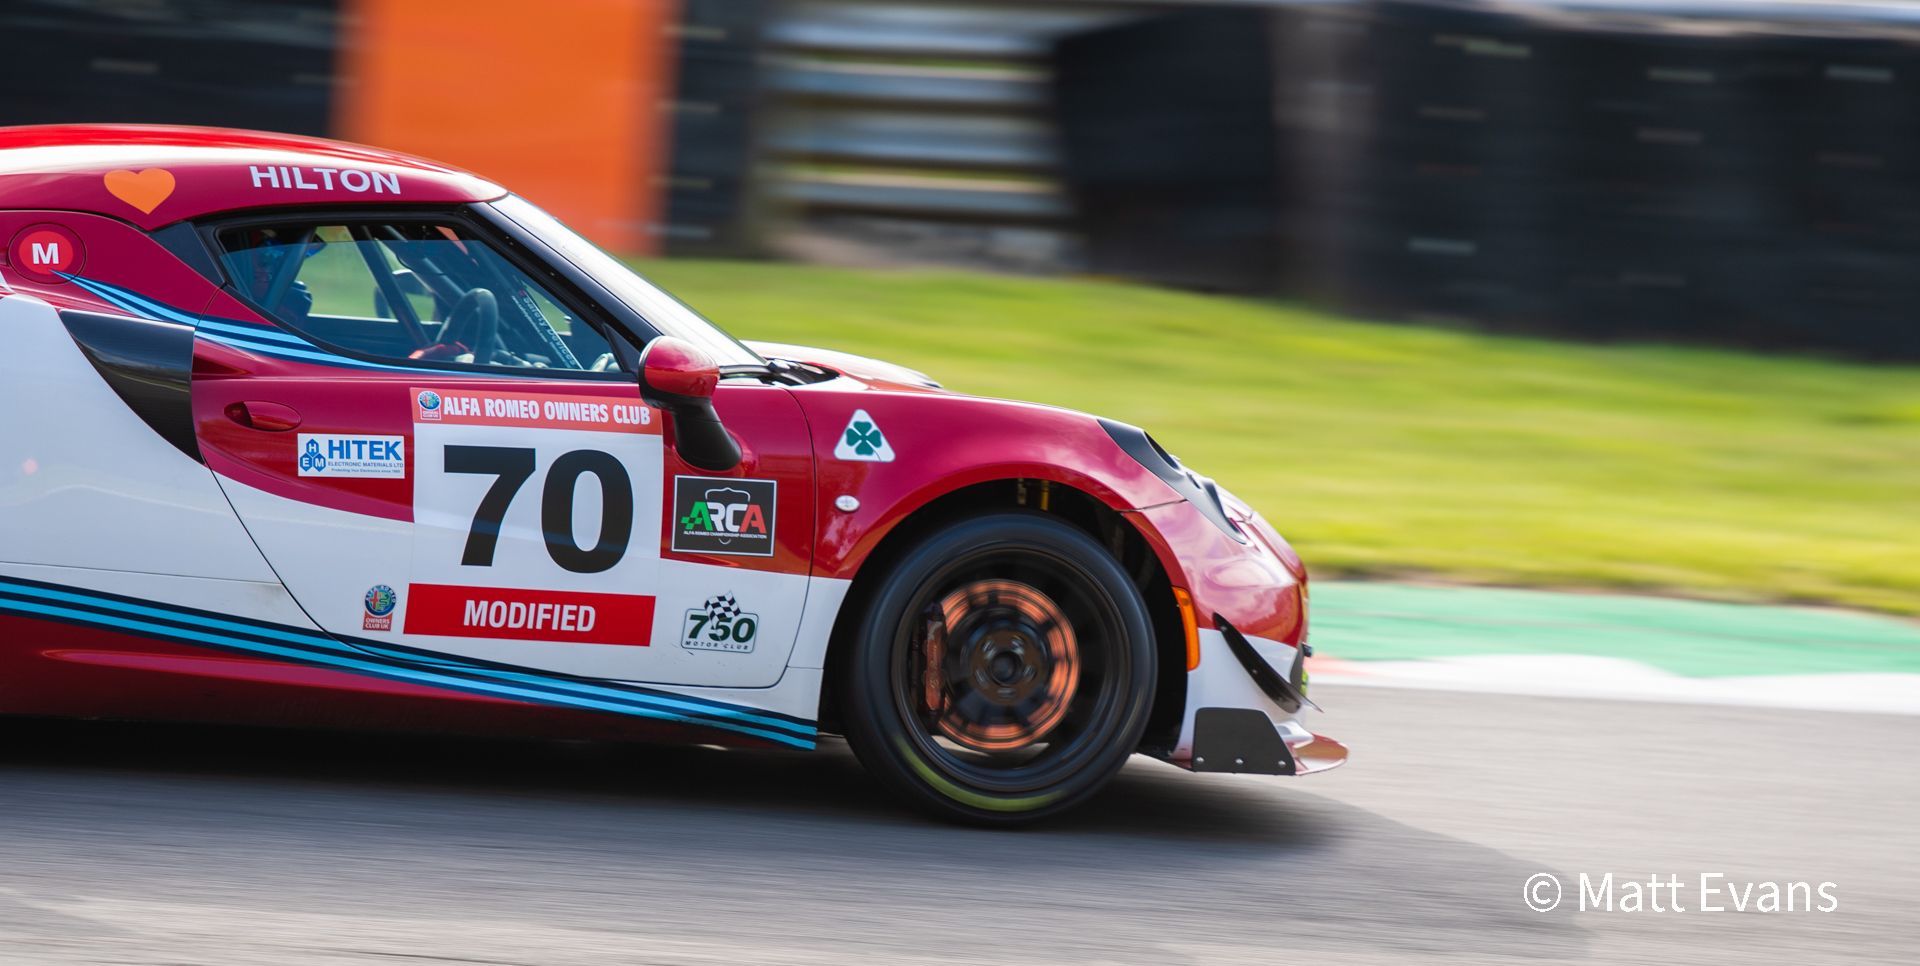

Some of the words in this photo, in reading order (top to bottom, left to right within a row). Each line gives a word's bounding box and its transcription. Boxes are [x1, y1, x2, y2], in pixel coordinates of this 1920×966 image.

[249, 165, 401, 195] HILTON
[32, 243, 59, 265] M
[521, 296, 548, 329] Safety
[546, 327, 577, 366] Devices
[444, 396, 481, 416] ALFA
[485, 398, 540, 420] ROMEO
[544, 401, 609, 423] OWNERS
[613, 405, 651, 425] CLUB
[302, 457, 310, 467] E
[315, 458, 324, 468] M
[308, 443, 317, 453] H
[328, 439, 402, 461] HITEK
[444, 444, 634, 574] 70
[681, 501, 767, 534] ARCA
[463, 600, 596, 633] MODIFIED
[688, 614, 756, 643] 750
